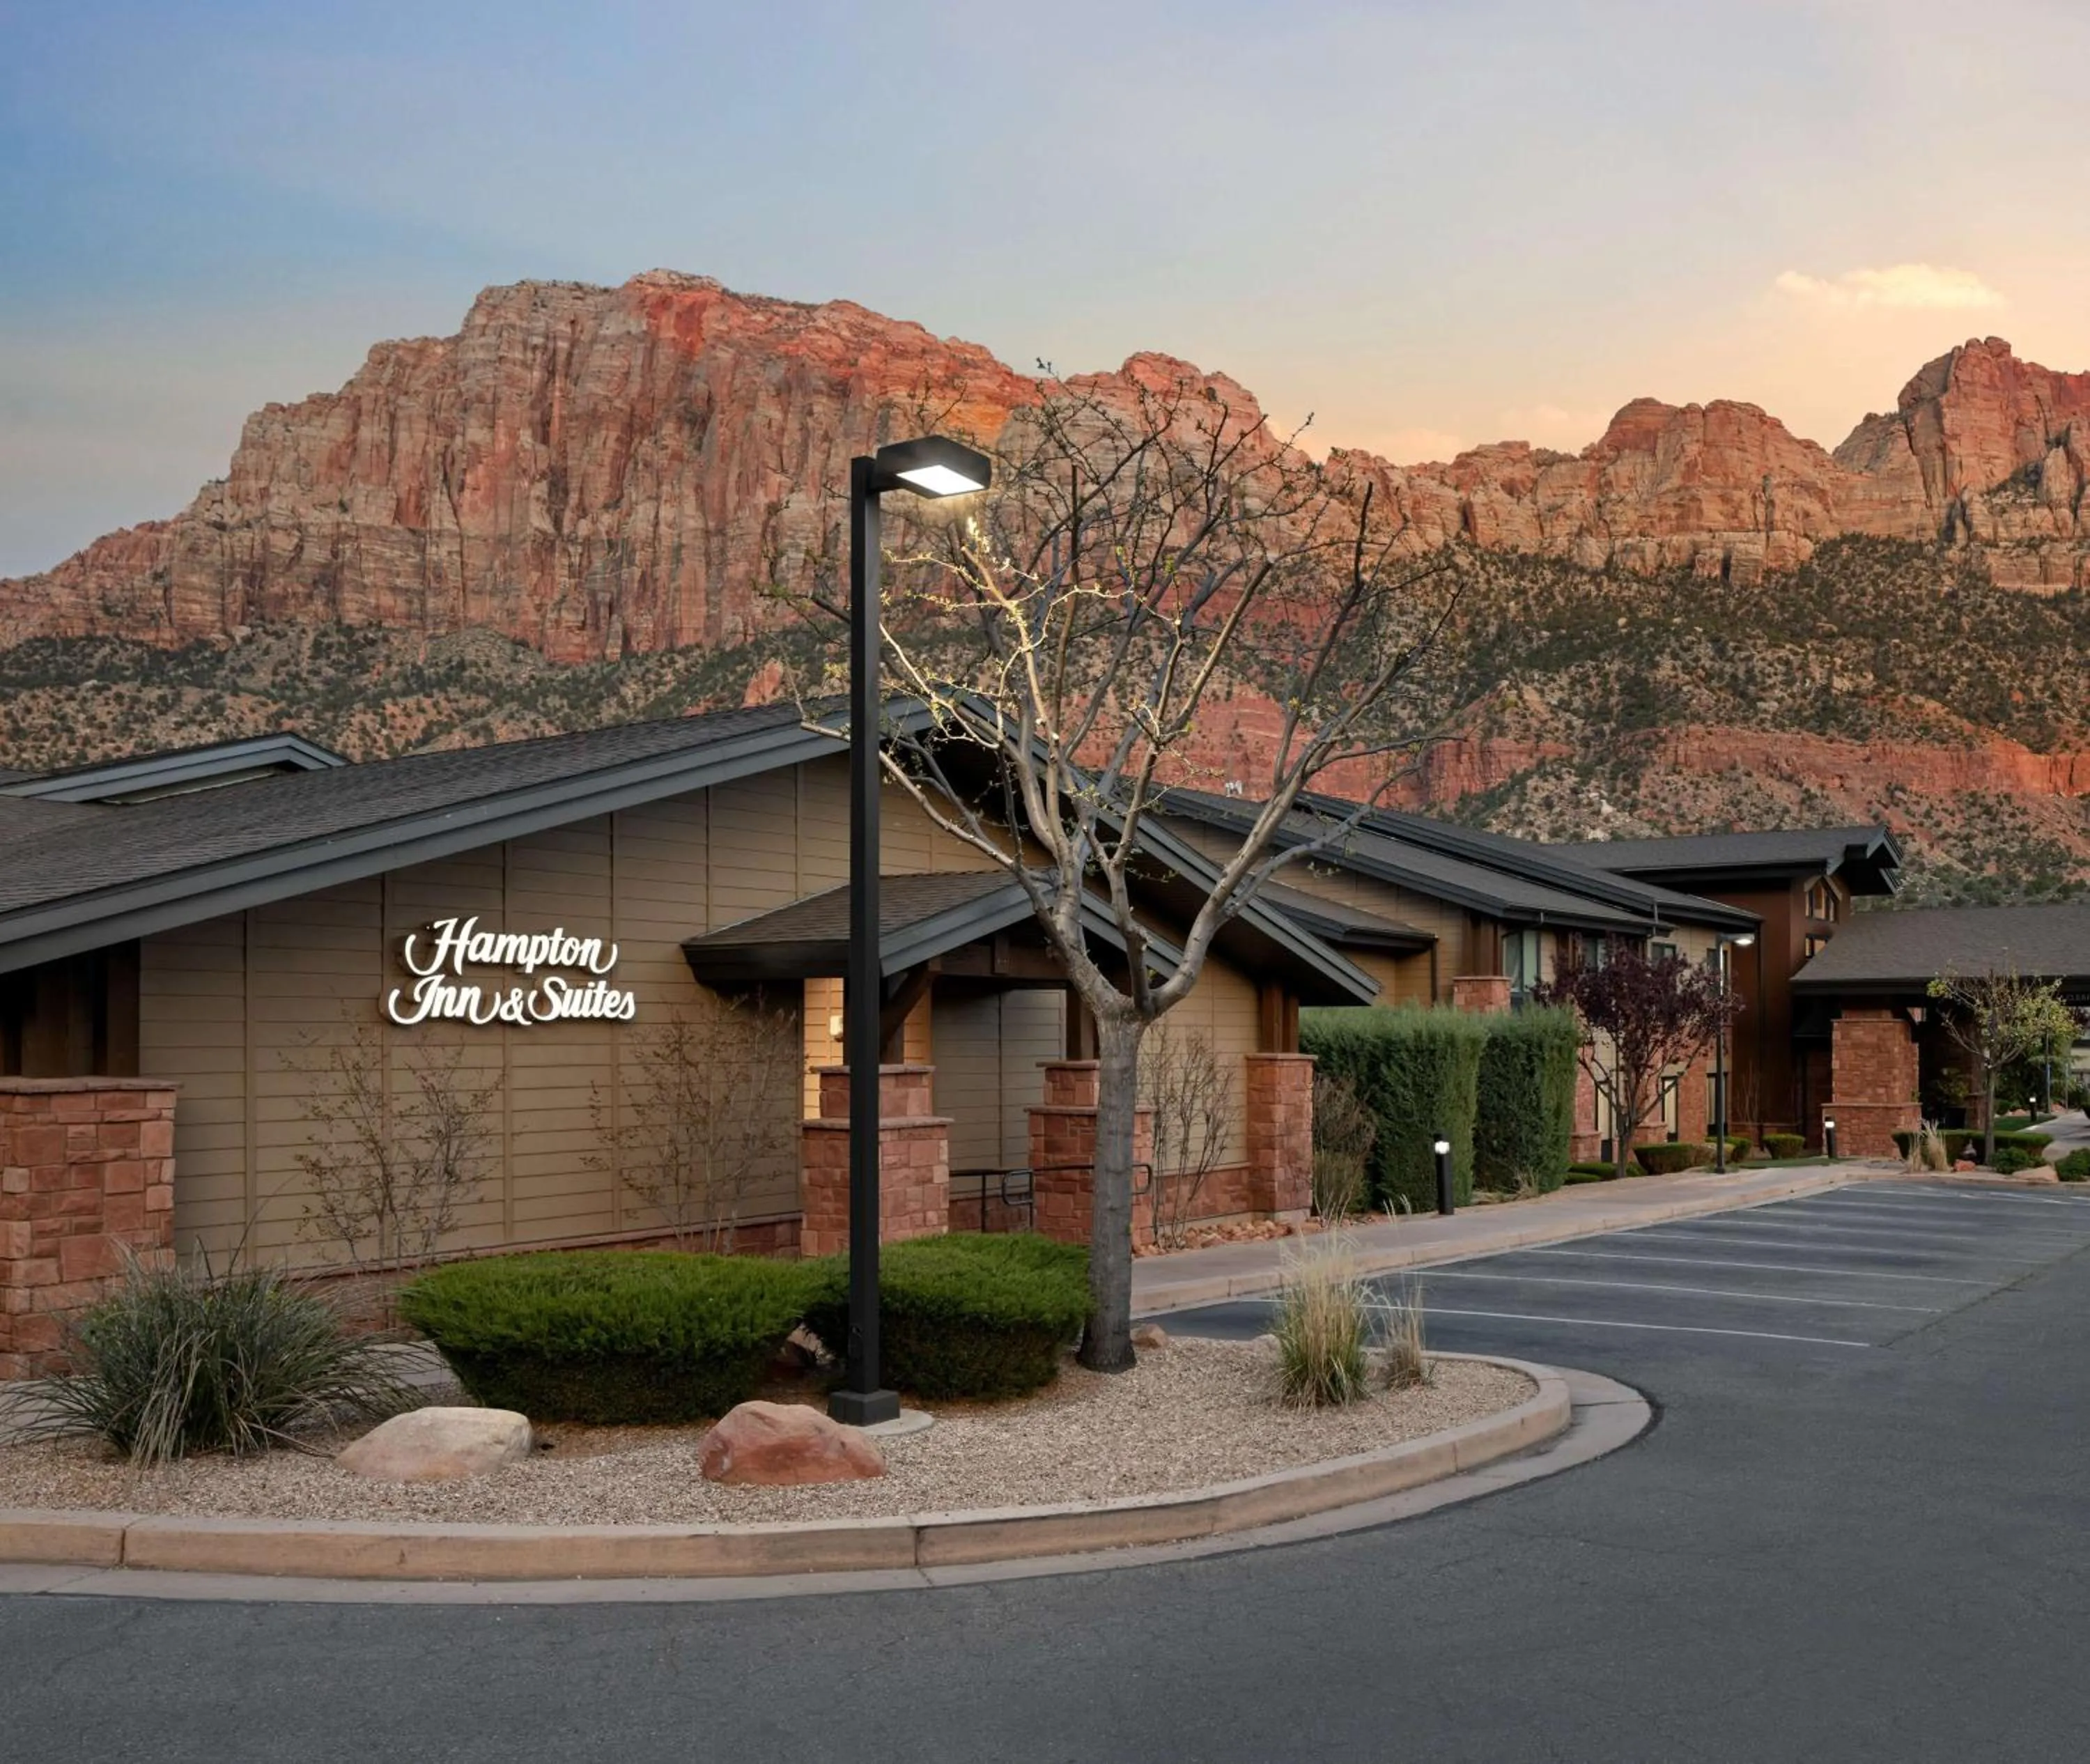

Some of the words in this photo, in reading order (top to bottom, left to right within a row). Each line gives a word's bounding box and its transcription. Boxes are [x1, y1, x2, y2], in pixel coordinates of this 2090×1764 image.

[405, 916, 618, 976] Hampton
[388, 974, 501, 1024] Inn
[500, 987, 532, 1026] &
[527, 976, 635, 1021] Suites
